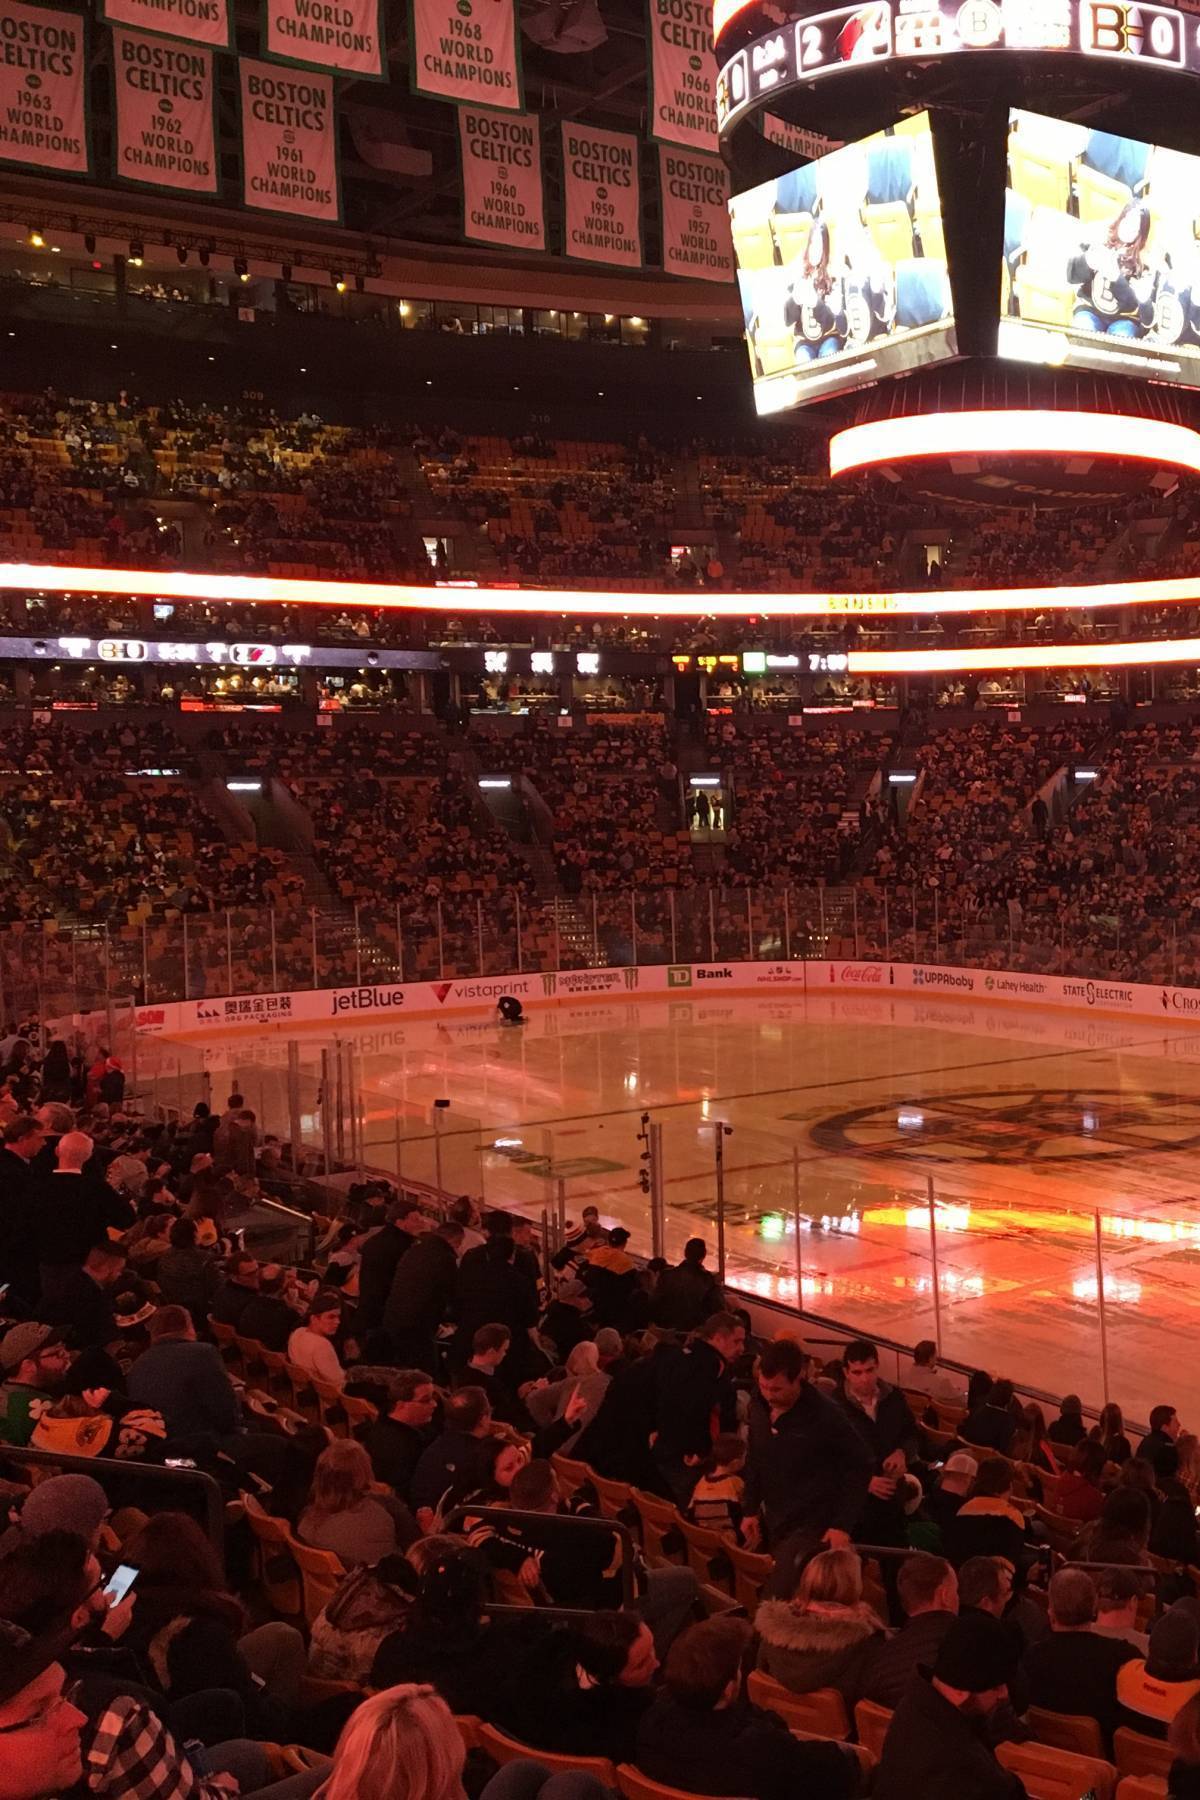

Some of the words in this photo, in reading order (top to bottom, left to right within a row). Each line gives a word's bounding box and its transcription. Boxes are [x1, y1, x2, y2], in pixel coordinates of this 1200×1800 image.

[1, 17, 76, 53] OSTON
[276, 16, 372, 53] CHAMPIONS
[448, 17, 482, 41] 1968
[661, 20, 716, 55] CELTIC
[1151, 15, 1173, 55] 0
[440, 37, 494, 64] WORLD
[802, 25, 823, 65] 2
[0, 41, 73, 77] ELTICS
[122, 40, 206, 78] BOSTON
[424, 54, 512, 88] CHAMPIONS
[126, 66, 203, 101] CELTICS
[248, 75, 326, 109] BOSTON
[682, 72, 710, 93] 1966
[17, 90, 51, 111] 1963
[7, 107, 63, 132] WORLD
[151, 114, 182, 135] 1962
[252, 100, 325, 132] CELTICS
[660, 105, 718, 134] CHAMPIO
[0, 126, 80, 155] HAMPIONS
[141, 131, 194, 155] WORLD
[465, 114, 534, 147] BOSTON
[124, 146, 210, 176] CHAMPIONS
[276, 146, 303, 163] 1961
[470, 138, 532, 168] CELTICS
[569, 137, 633, 167] BOSTON
[267, 162, 316, 184] WORLD
[572, 160, 631, 188] CELTICS
[666, 157, 725, 187] BOSTON
[251, 176, 332, 204] CHAMPIONS
[490, 180, 517, 199] 1960
[669, 179, 724, 207] CELTICS
[484, 196, 526, 217] WORLD
[591, 201, 615, 217] 1959
[471, 210, 540, 236] CHAMPIONS
[584, 216, 624, 235] WORLD
[688, 219, 711, 234] 1957
[572, 230, 637, 253] CHAMPIONS
[681, 233, 718, 251] WORLD
[668, 247, 731, 270] CHAMPIONS
[455, 980, 530, 999] vistaprint
[671, 969, 691, 985] TD
[696, 969, 733, 980] Bank
[925, 971, 974, 991] UPPAbaby
[997, 979, 1018, 993] Lahey
[1019, 981, 1047, 993] Health
[332, 988, 404, 1015] jetBlue
